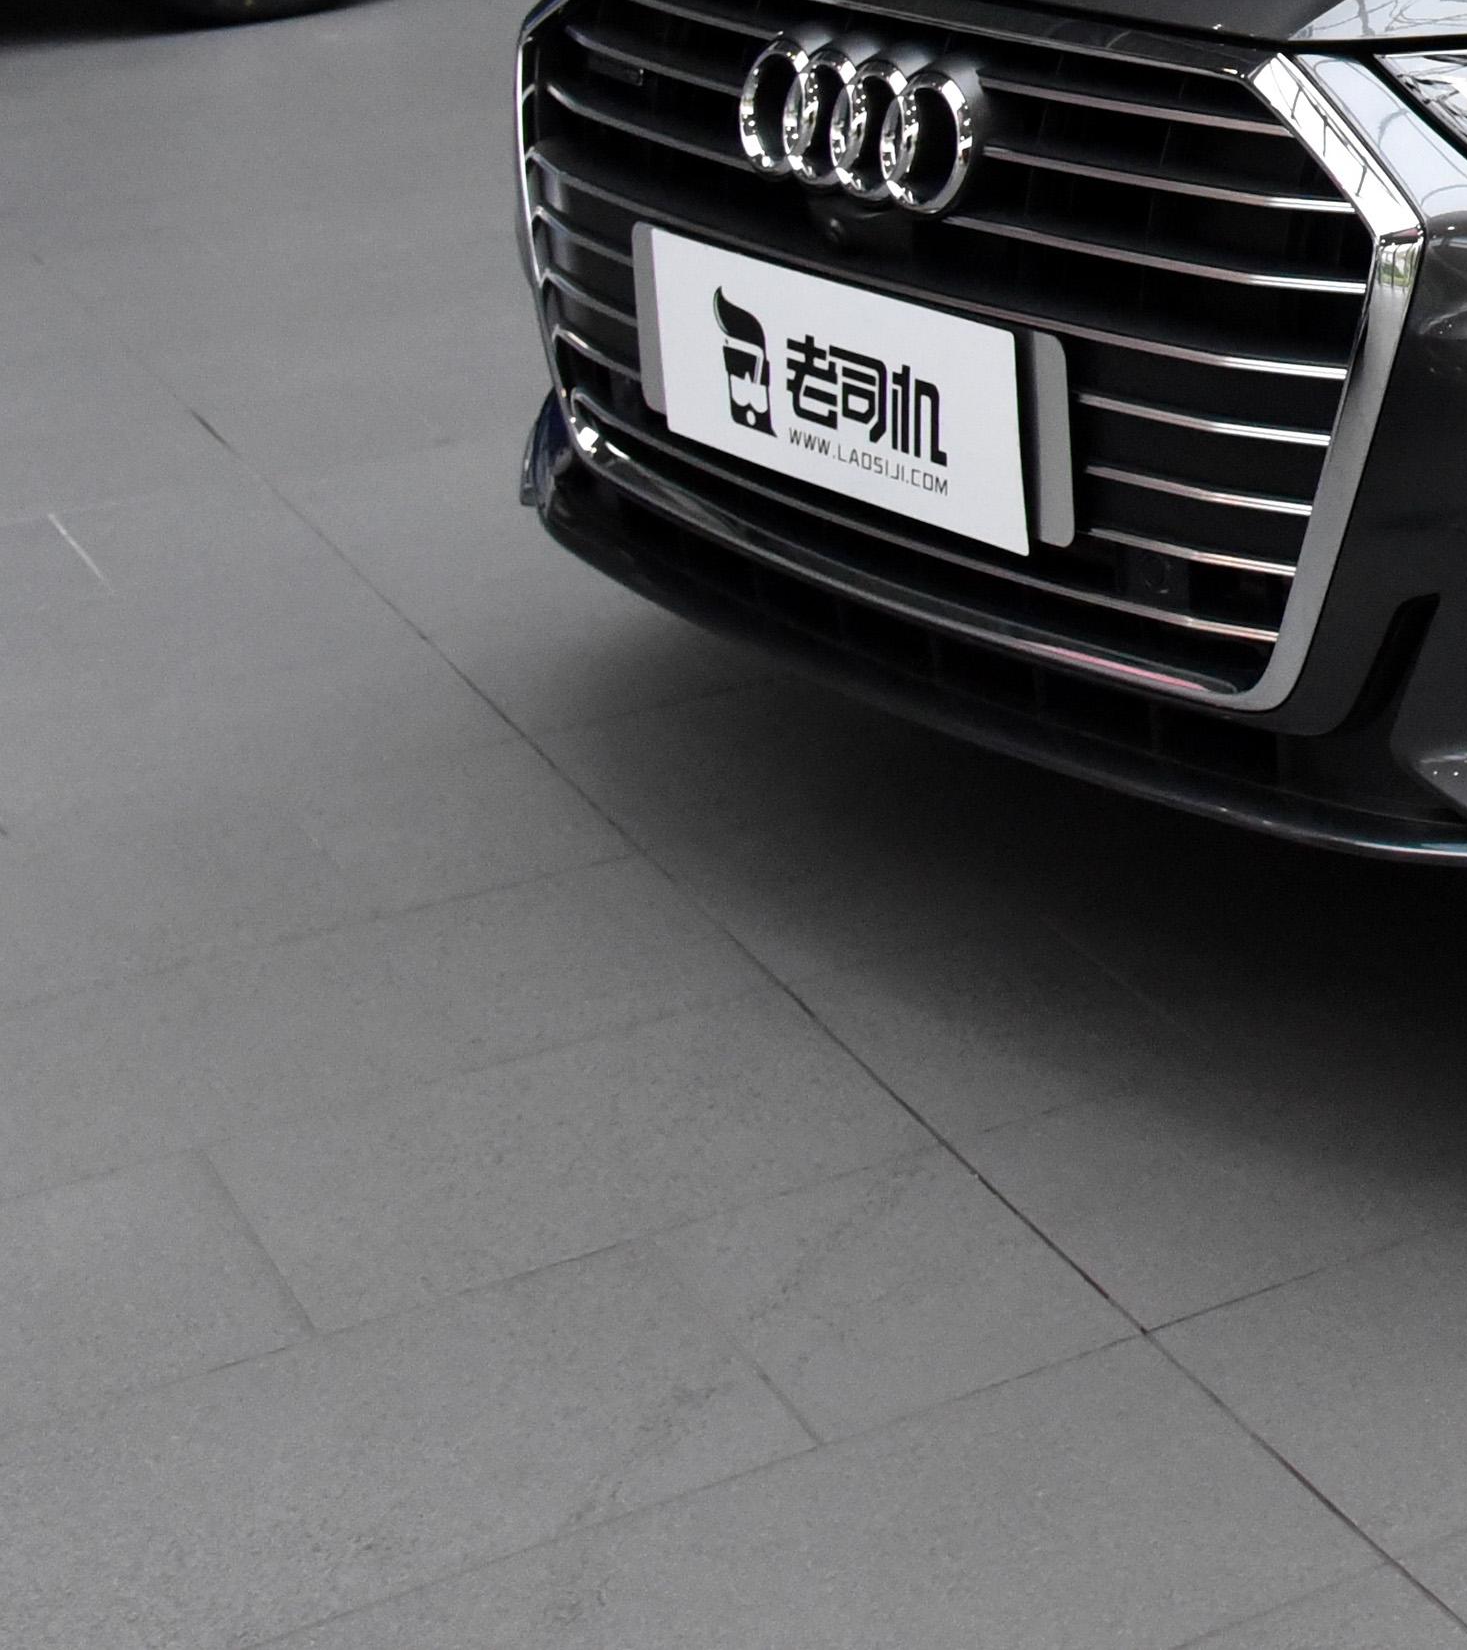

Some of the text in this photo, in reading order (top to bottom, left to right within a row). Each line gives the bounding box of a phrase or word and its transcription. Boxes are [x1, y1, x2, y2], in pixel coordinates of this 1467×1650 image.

[787, 334, 948, 467] 老司机
[789, 427, 949, 497] WWW.LAOSIJI.COM
